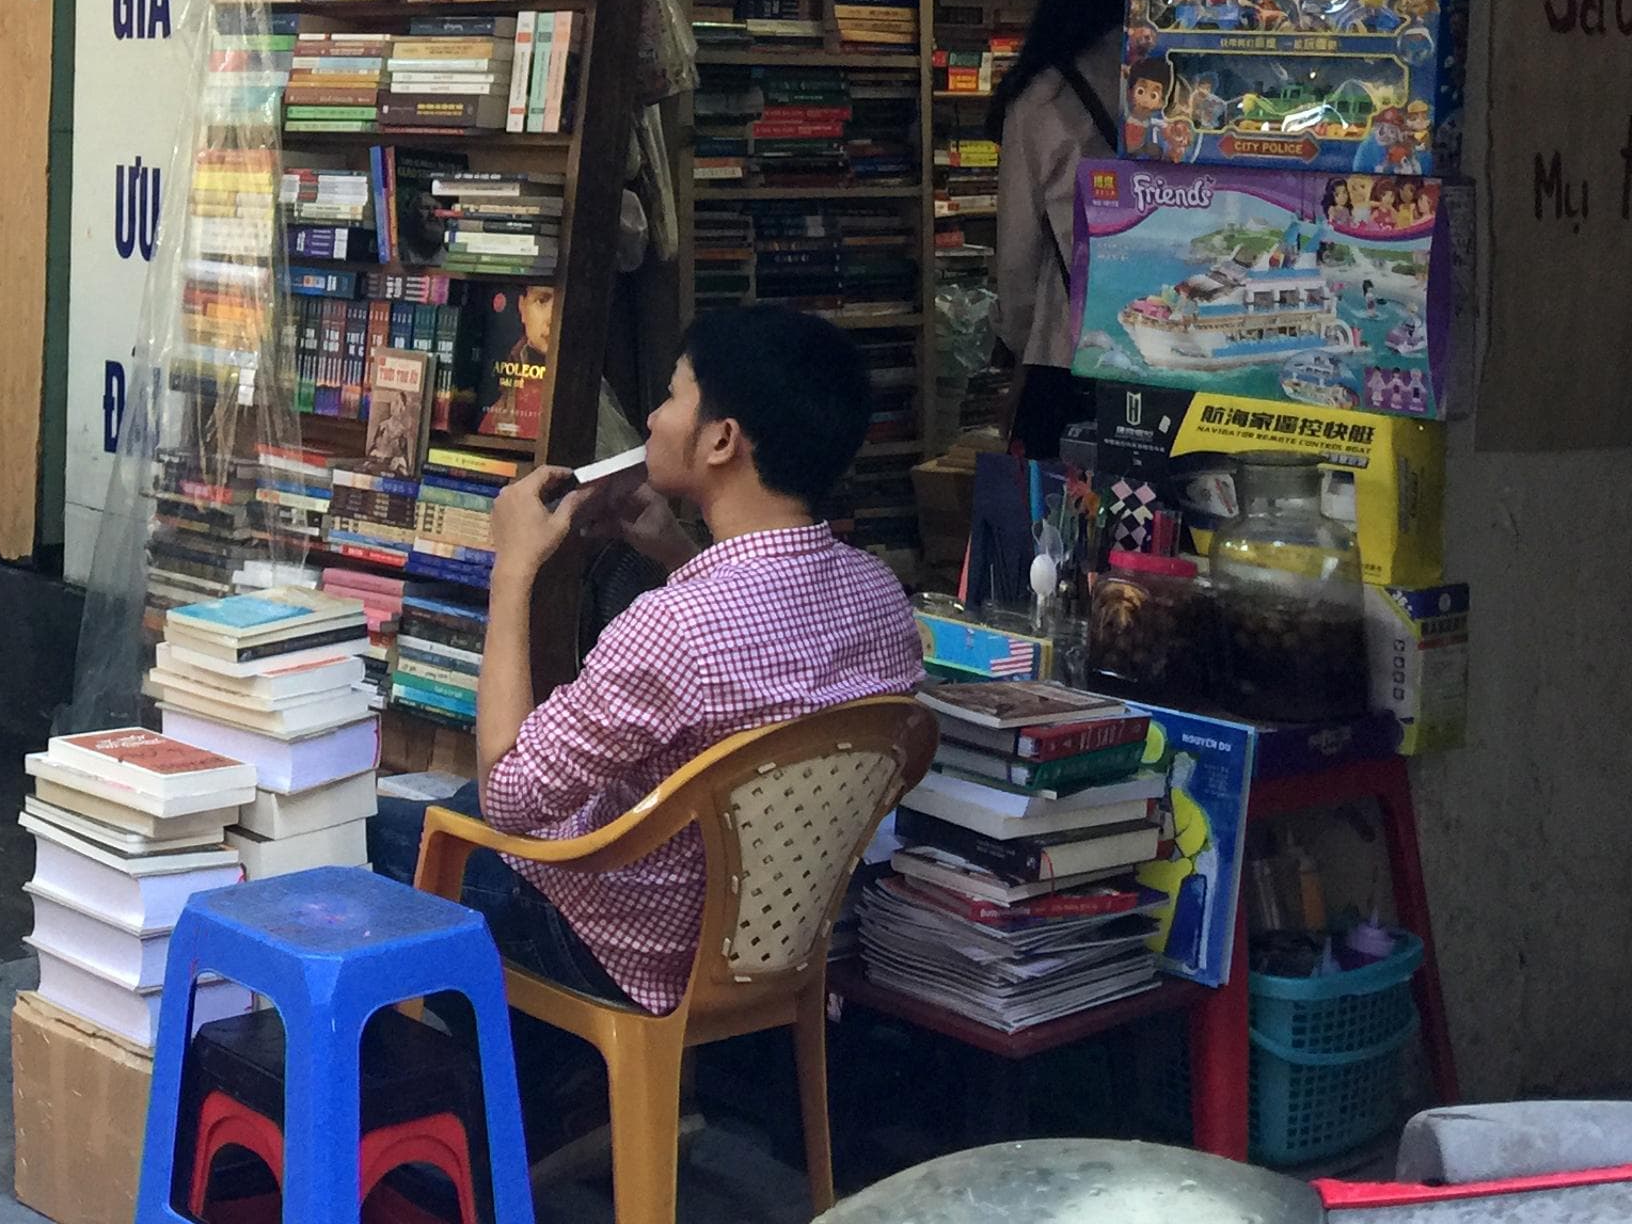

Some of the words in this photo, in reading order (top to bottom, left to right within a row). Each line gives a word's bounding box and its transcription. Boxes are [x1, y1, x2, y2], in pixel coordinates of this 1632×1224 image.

[1234, 141, 1260, 154] CITY
[1262, 142, 1304, 155] POLICE
[1132, 174, 1214, 211] Friends
[1196, 426, 1255, 440] NAVIGATOR
[1298, 438, 1343, 451] CONTROL
